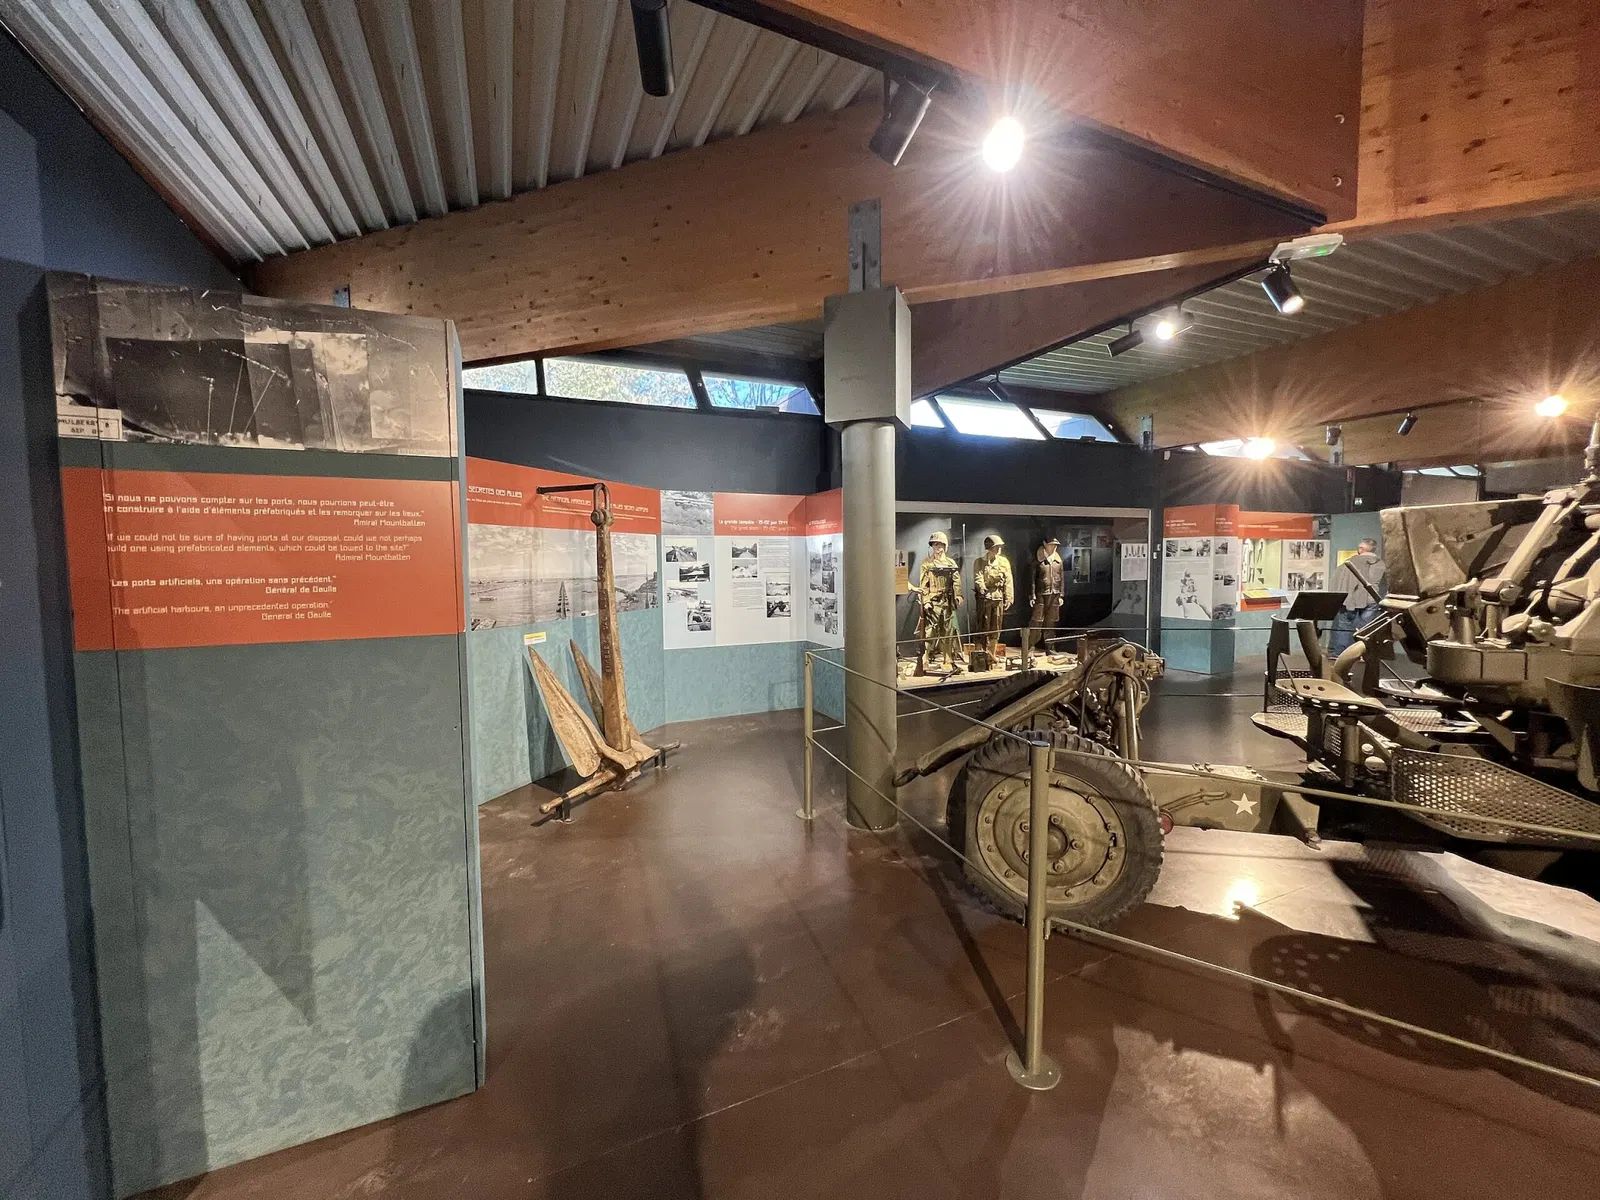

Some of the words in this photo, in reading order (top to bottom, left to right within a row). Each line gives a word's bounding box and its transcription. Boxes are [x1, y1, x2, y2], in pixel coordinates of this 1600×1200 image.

[159, 496, 198, 504] pouvons
[200, 496, 236, 504] compter
[255, 497, 269, 505] les
[320, 499, 357, 507] pourrions
[116, 505, 164, 513] construire
[253, 508, 306, 517] préfabriqués
[308, 508, 317, 516] et
[319, 508, 331, 516] les
[353, 518, 378, 526] Amiral
[380, 519, 426, 527] Mountbatten
[134, 533, 159, 541] could
[179, 533, 190, 541] be
[215, 533, 224, 541] of
[226, 533, 255, 543] having
[257, 534, 278, 542] ports
[343, 534, 364, 542] could
[150, 545, 175, 553] using
[177, 544, 234, 553] prefabricated
[278, 544, 302, 552] which
[304, 544, 326, 552] could
[327, 544, 338, 552] be
[340, 544, 364, 552] towed
[335, 553, 363, 561] Admiral
[365, 553, 411, 561] Mountbatten
[131, 579, 157, 588] ports
[225, 577, 266, 586] opération
[265, 586, 297, 594] Général
[312, 585, 338, 593] Gaulle
[133, 606, 168, 615] artificial
[228, 602, 289, 613] unprecedented
[261, 613, 293, 621] General
[307, 611, 332, 619] Gaulle
